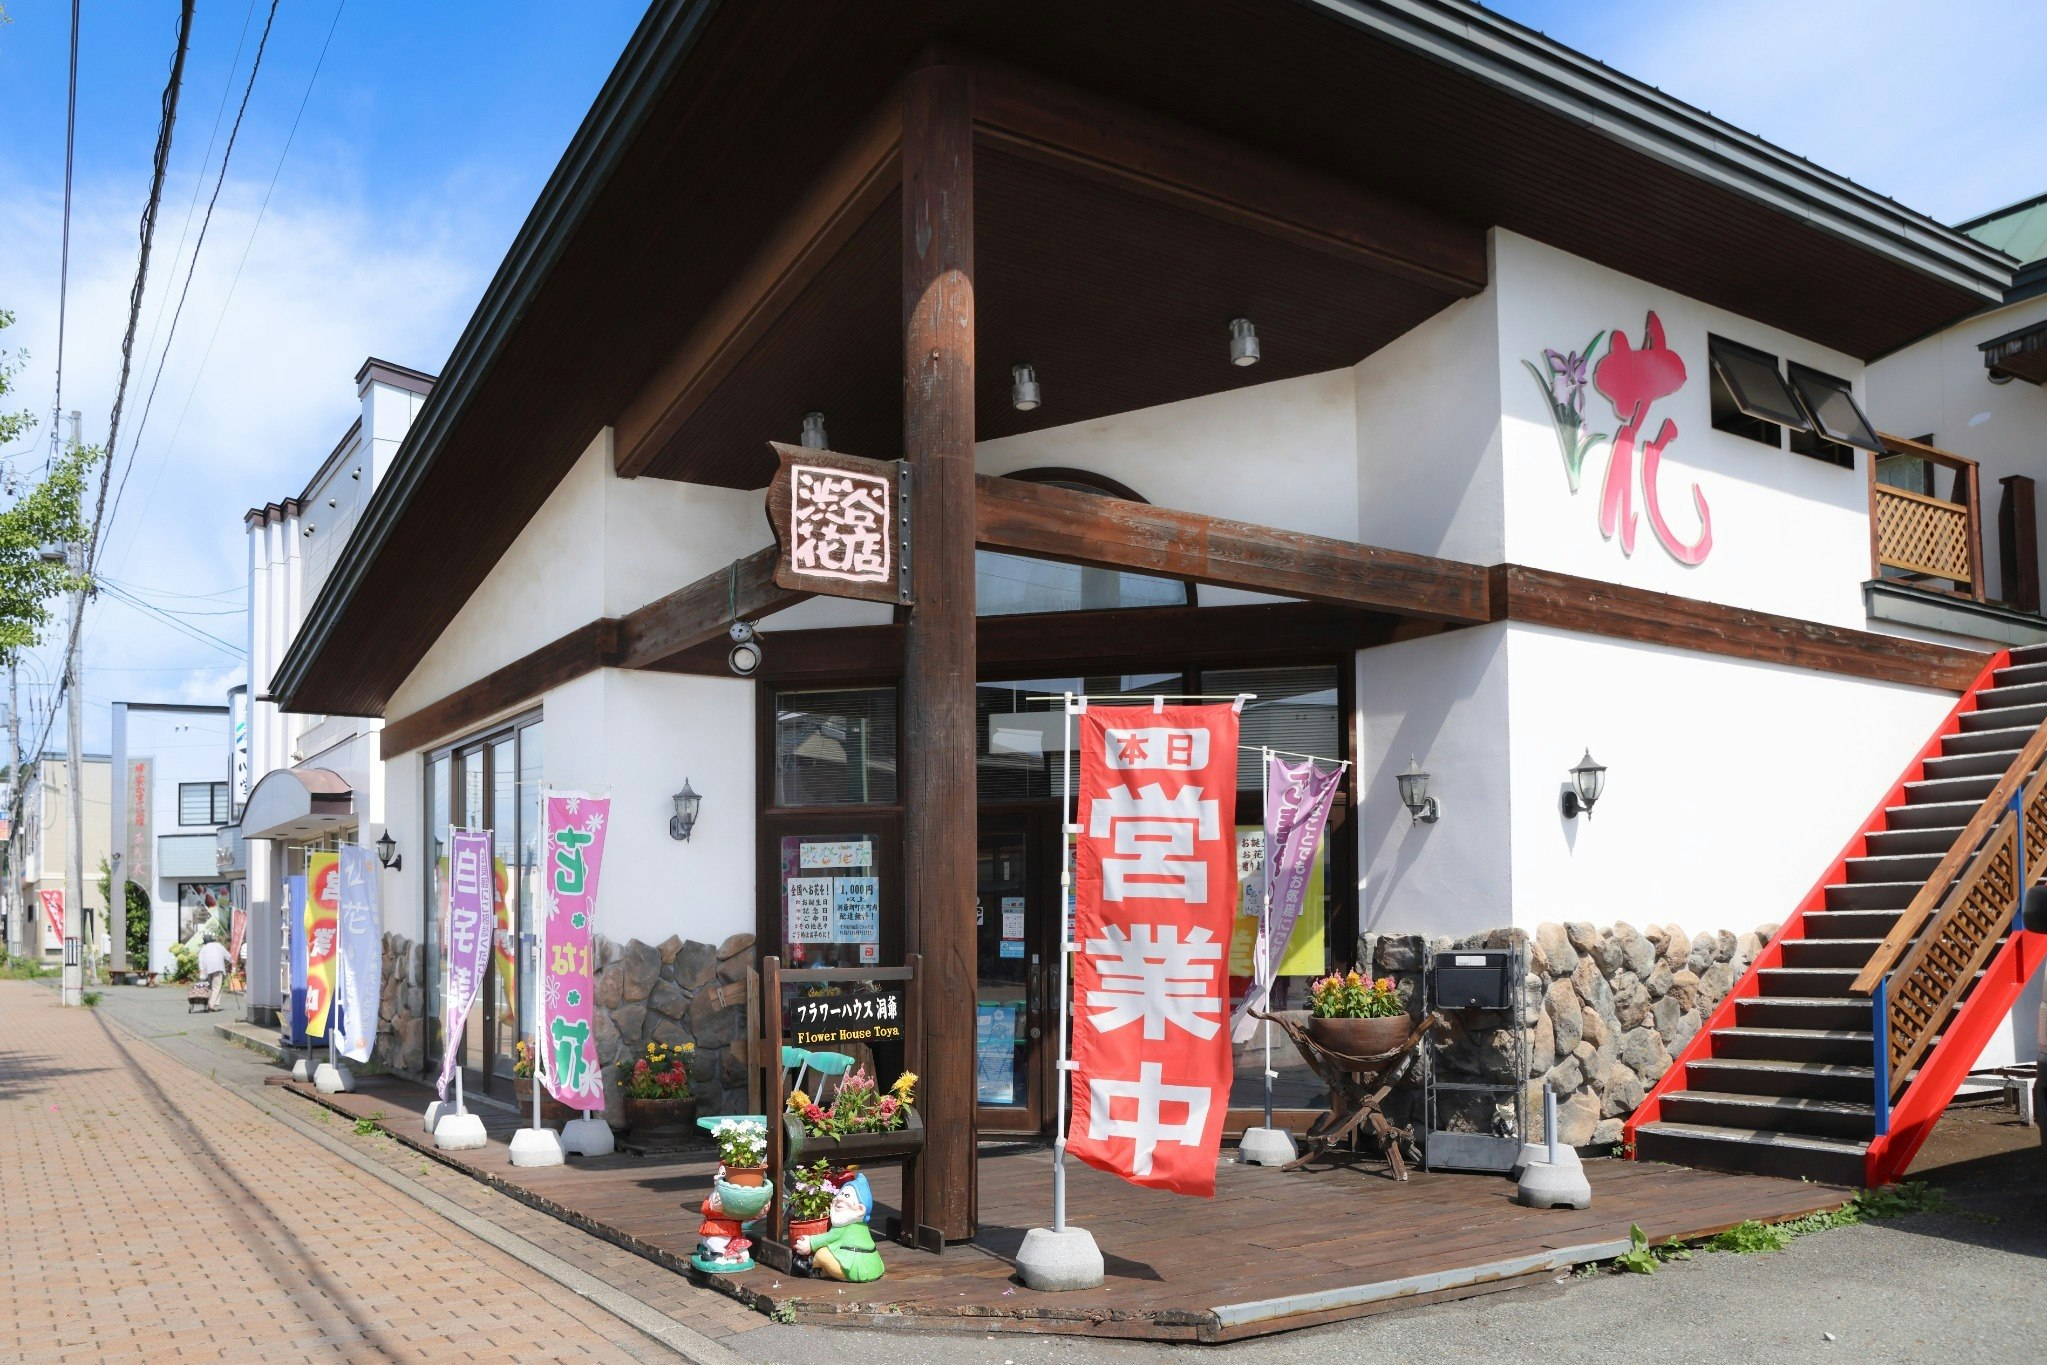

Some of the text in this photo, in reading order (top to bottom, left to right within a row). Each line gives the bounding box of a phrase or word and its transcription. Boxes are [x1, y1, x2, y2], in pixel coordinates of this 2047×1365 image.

[1594, 311, 1713, 566] 花
[796, 474, 885, 528] 渋谷
[796, 523, 885, 571] 花店
[1117, 734, 1193, 767] 本日
[342, 859, 369, 935] 仏花
[791, 884, 829, 896] 全国へお花を!
[840, 884, 873, 895] 1,000円
[1089, 783, 1222, 1176] 営業中
[798, 1026, 900, 1044] Flower House Toya
